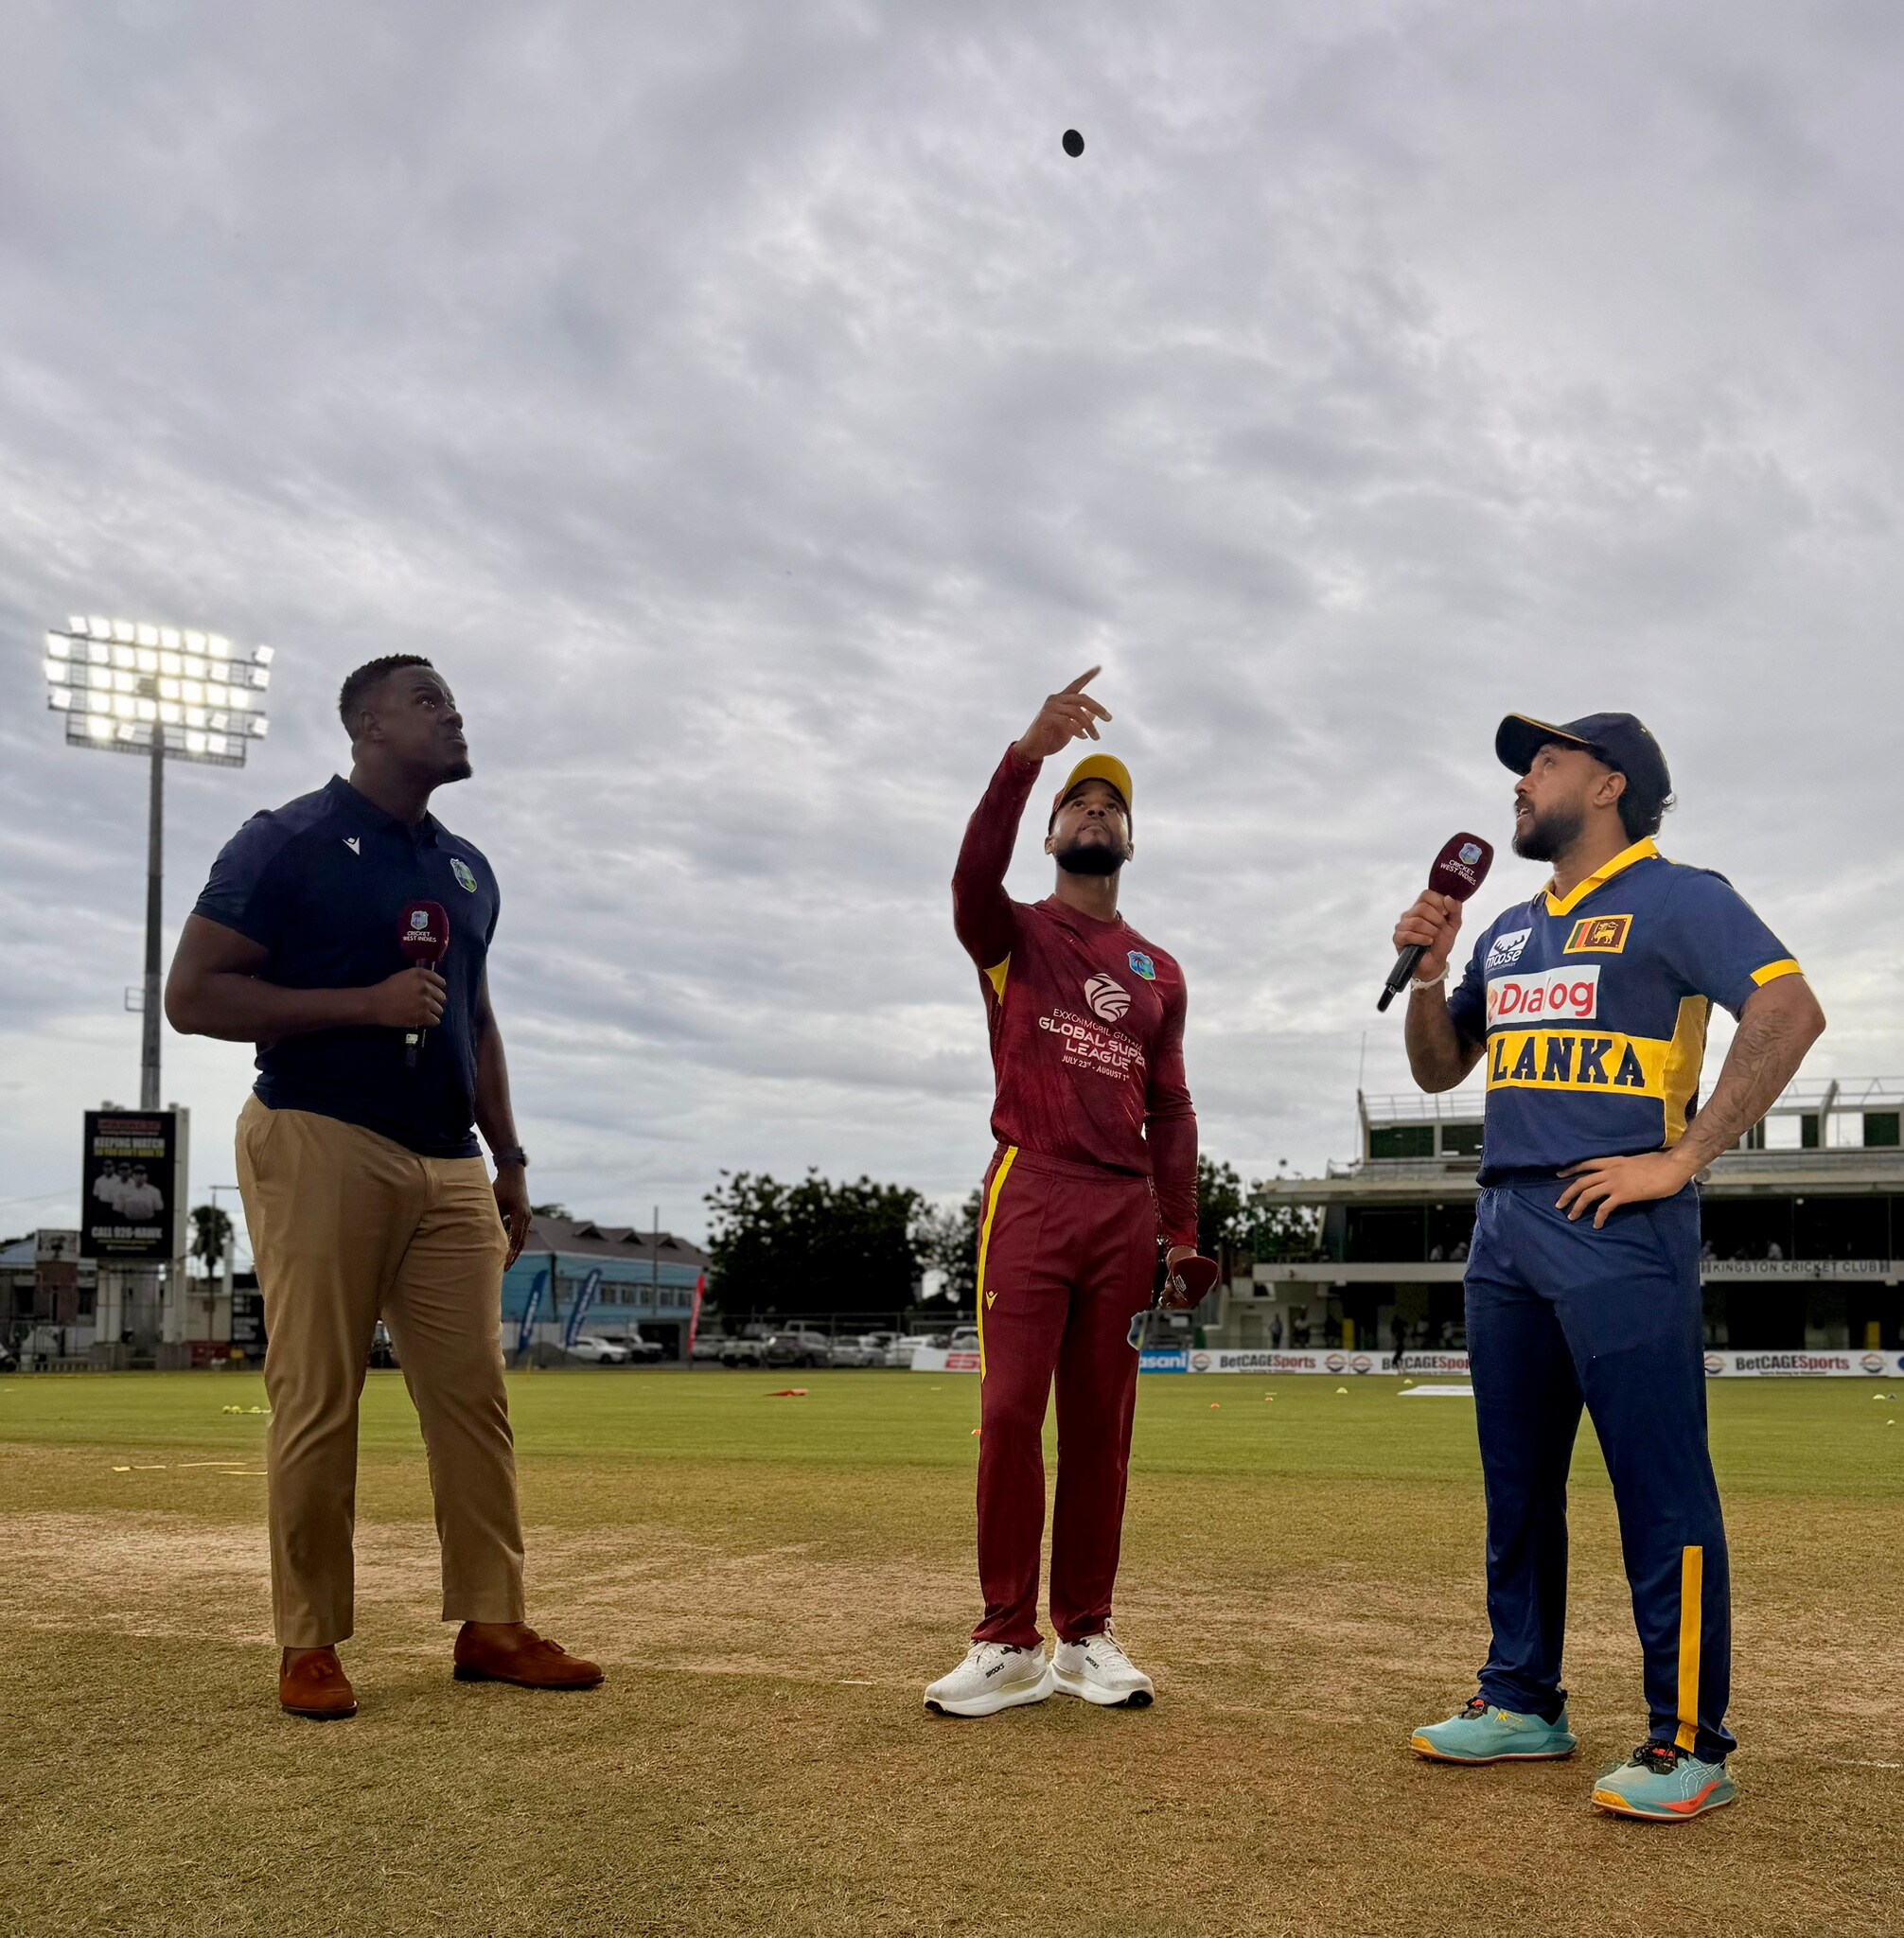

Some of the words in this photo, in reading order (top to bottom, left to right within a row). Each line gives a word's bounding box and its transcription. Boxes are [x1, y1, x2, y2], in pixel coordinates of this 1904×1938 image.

[1440, 862, 1458, 873] WEST
[1457, 870, 1477, 886] INDIES
[1449, 859, 1474, 876] CRICKET
[1485, 949, 1523, 970] moose
[1497, 976, 1595, 1017] Dialog
[1038, 1016, 1106, 1048] GLOBAL
[1107, 1040, 1146, 1067] SUPE
[1066, 1039, 1132, 1071] LEAGUE
[1492, 1036, 1646, 1088] LANKA
[1062, 1054, 1078, 1065] JULY
[1096, 1066, 1122, 1079] AUGUST
[1713, 1261, 1778, 1273] KINGSTON
[1782, 1261, 1837, 1273] CRICKET
[1842, 1261, 1878, 1273] CLUB
[1139, 1352, 1186, 1368] asani
[1220, 1353, 1316, 1369] BetCAGESports
[1736, 1354, 1850, 1370] BetCAGESports
